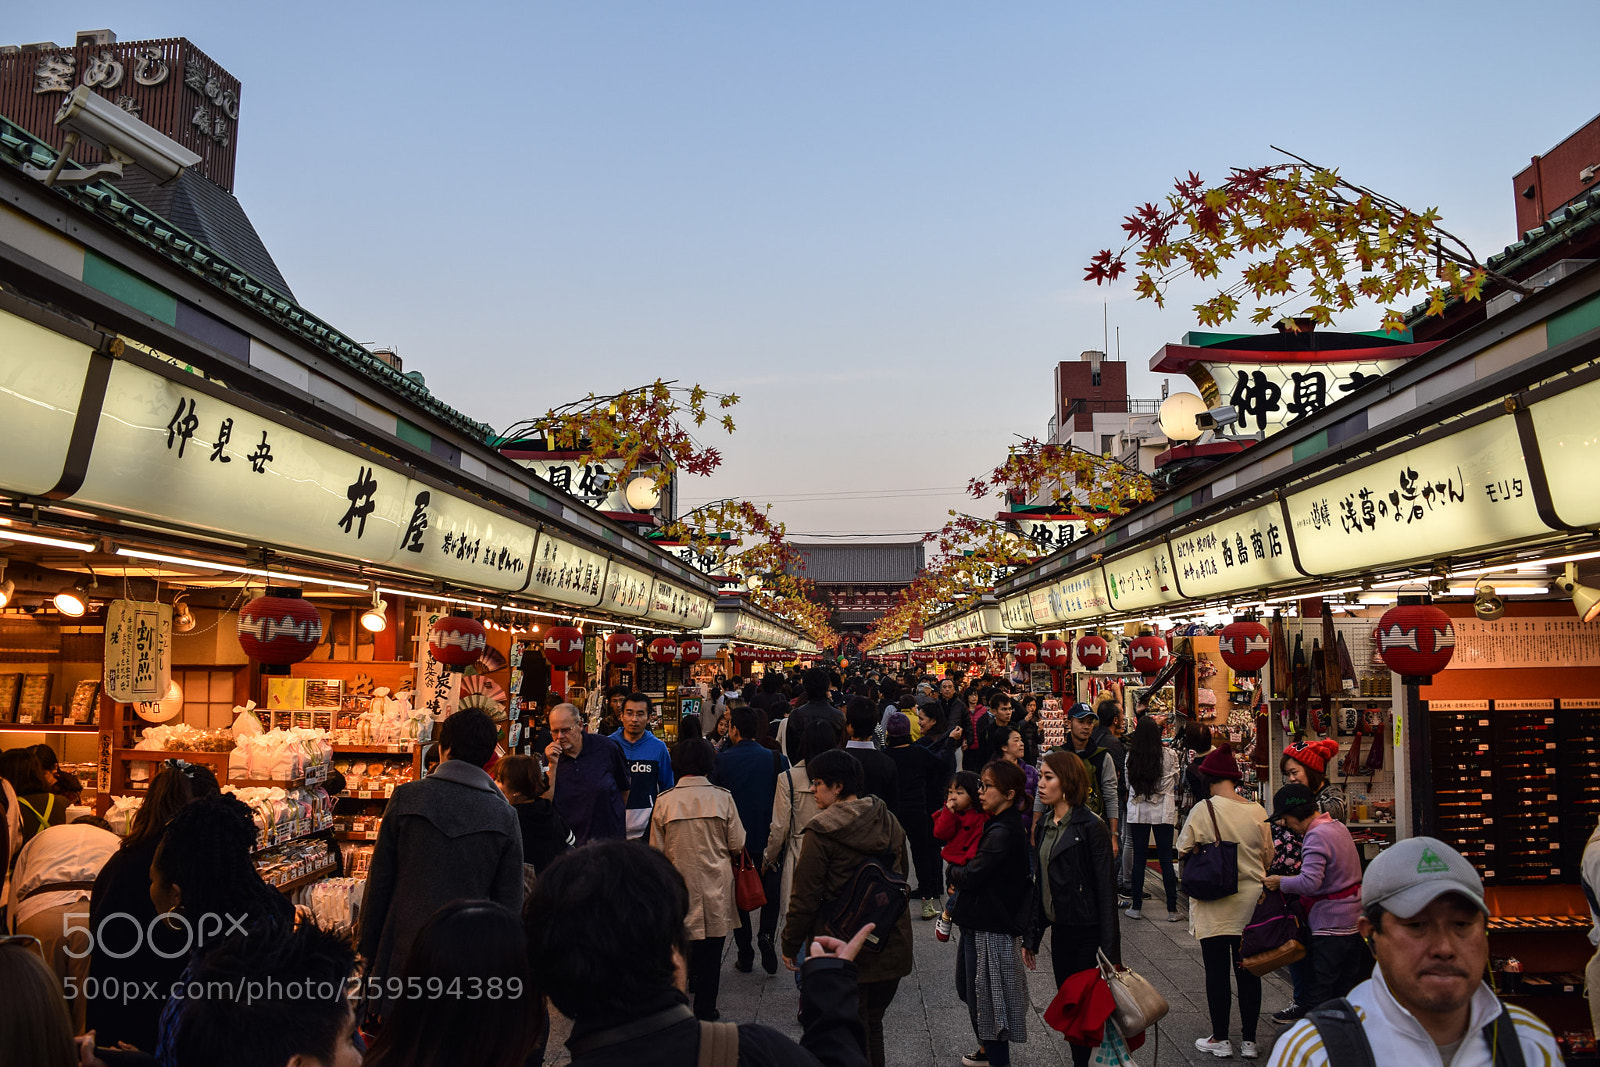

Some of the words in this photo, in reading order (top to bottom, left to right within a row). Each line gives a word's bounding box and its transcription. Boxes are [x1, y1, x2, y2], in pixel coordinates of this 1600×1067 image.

[167, 396, 275, 476] 仲見世
[337, 465, 432, 554] 杵屋
[1485, 477, 1524, 503] モリタ
[426, 672, 451, 716] 炭火焼
